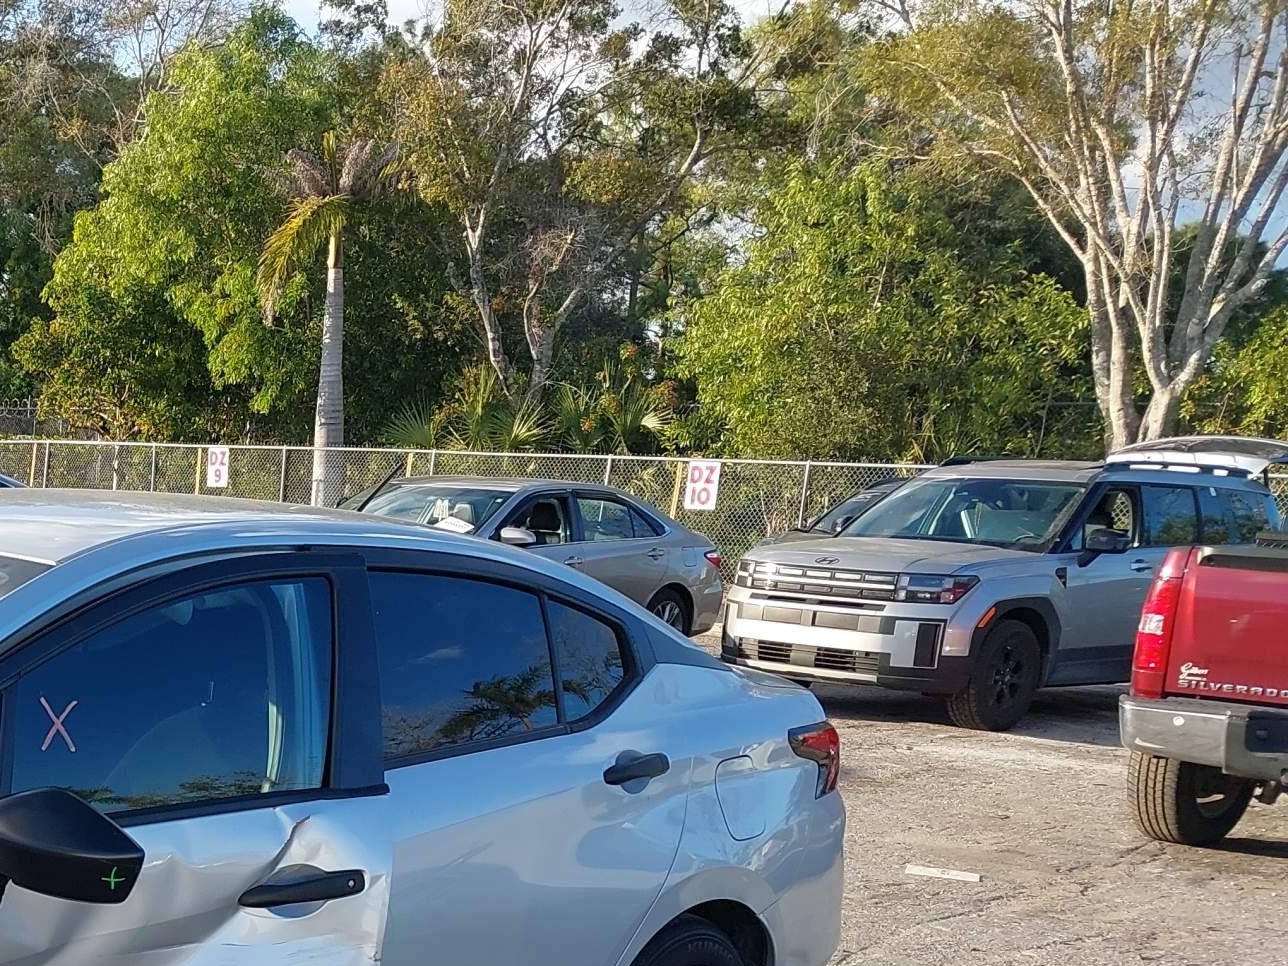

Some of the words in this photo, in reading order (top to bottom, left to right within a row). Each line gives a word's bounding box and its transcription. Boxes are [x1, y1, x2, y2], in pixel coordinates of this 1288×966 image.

[209, 450, 227, 466] DZ
[214, 468, 222, 483] 9
[689, 465, 717, 485] DZ
[1177, 679, 1288, 698] SILVERADO
